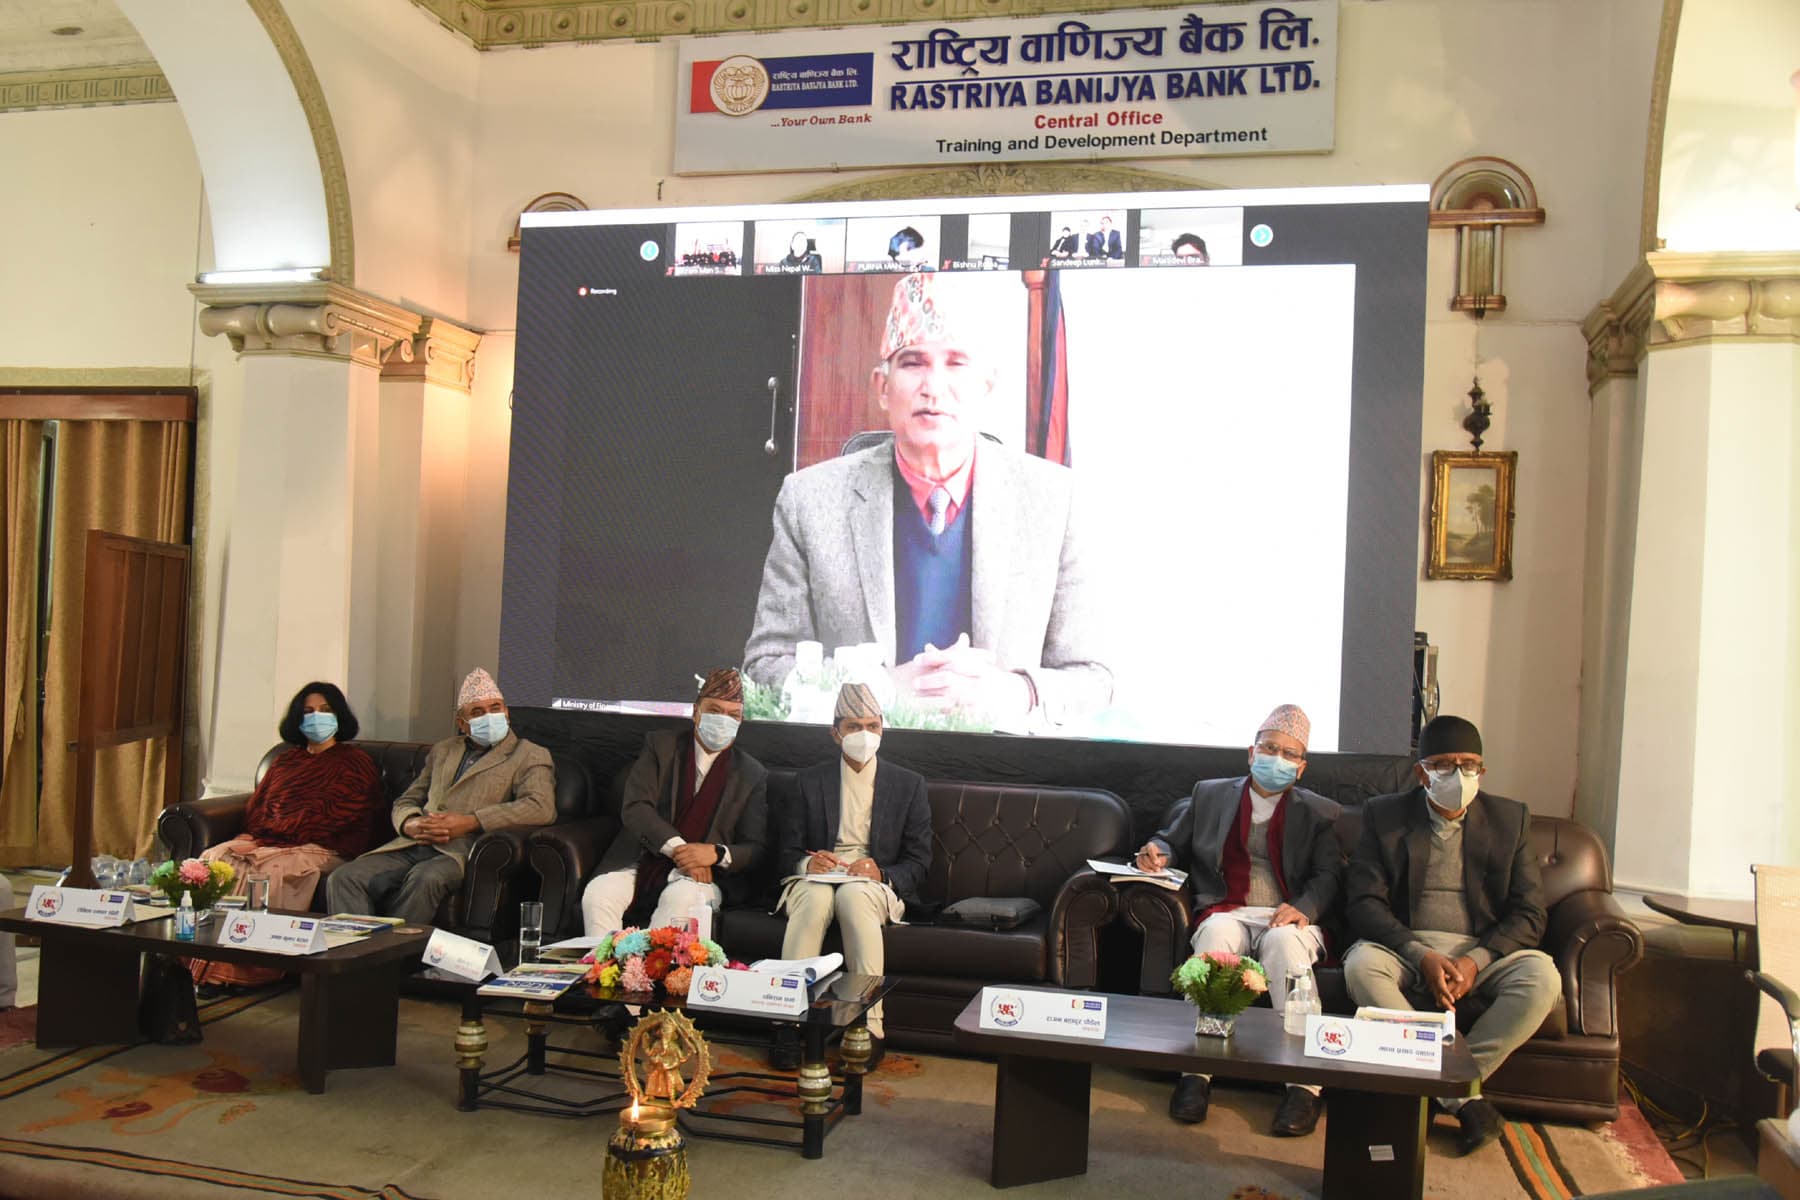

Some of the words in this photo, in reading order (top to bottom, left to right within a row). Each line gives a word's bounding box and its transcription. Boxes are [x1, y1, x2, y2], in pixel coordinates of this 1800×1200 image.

[892, 28, 1011, 77] राष्ट्रिय
[1020, 21, 1167, 62] वाणिज्य
[1179, 13, 1247, 54] बैंक
[1259, 8, 1319, 50] लि.
[771, 82, 800, 91] RASTRIYA
[801, 81, 826, 90] BANIJYA
[828, 80, 844, 89] BANK
[891, 81, 1027, 110] RASTRIYA
[1036, 74, 1156, 105] BANIJYA
[1167, 69, 1248, 99] BANK
[1260, 63, 1320, 94] LTD.
[809, 115, 835, 125] Own
[838, 113, 872, 124] Bank
[1034, 113, 1098, 129] Central
[1107, 111, 1163, 126] Office
[936, 138, 1001, 154] Training
[1008, 136, 1038, 150] and
[1045, 132, 1155, 150] Development
[1161, 128, 1267, 147] Department
[562, 700, 588, 710] Ministry
[588, 701, 596, 709] of
